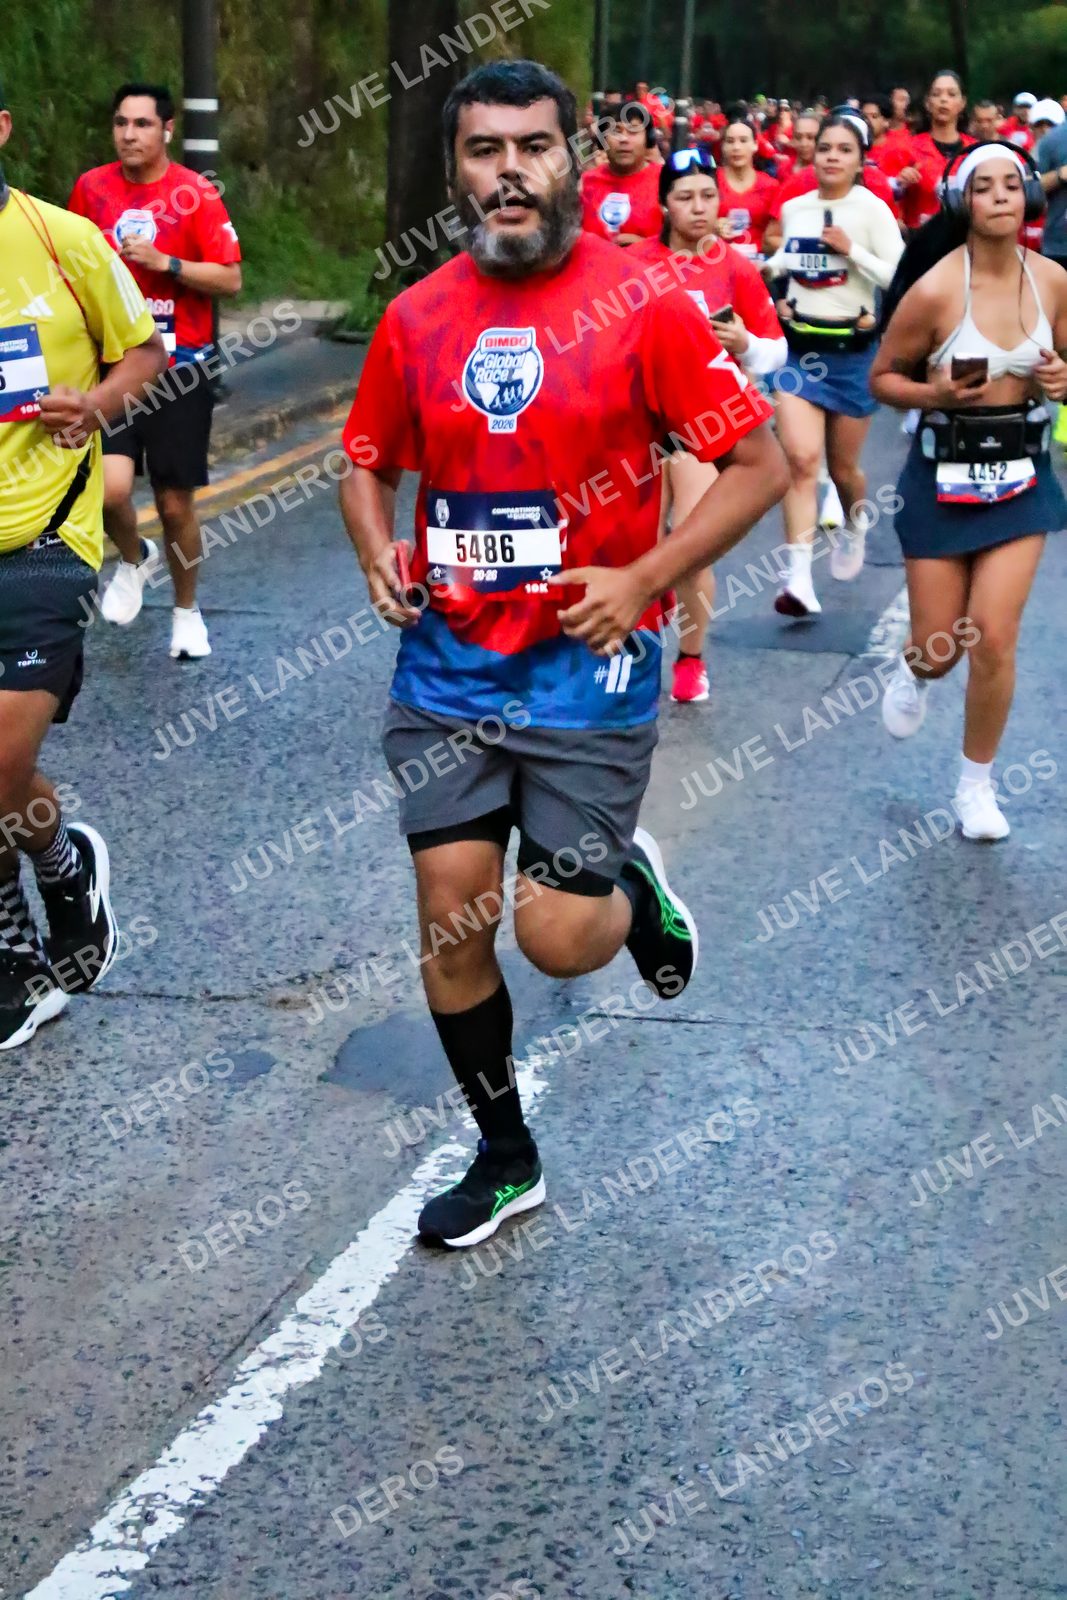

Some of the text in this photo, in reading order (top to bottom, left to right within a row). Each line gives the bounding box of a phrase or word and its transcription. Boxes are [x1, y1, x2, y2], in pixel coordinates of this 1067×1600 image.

[484, 352, 526, 369] Global
[474, 367, 510, 383] Race
[491, 419, 515, 430] 2026
[968, 461, 1008, 480] 4452
[455, 533, 515, 563] 5486
[524, 582, 549, 594] 10K
